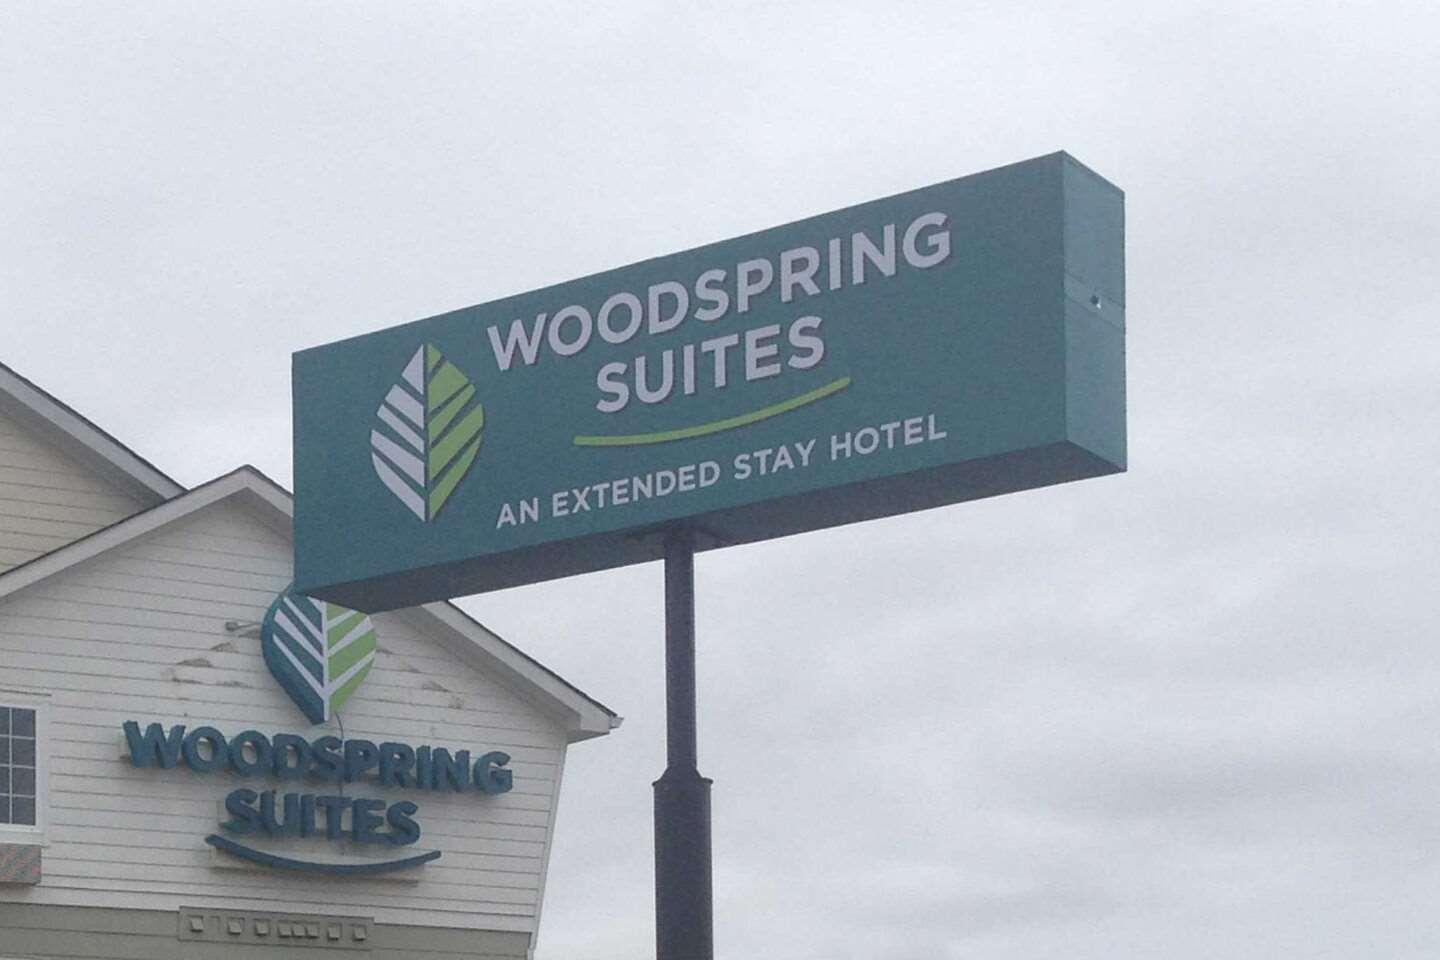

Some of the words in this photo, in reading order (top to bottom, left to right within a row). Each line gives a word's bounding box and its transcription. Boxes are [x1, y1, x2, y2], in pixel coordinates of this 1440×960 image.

[487, 212, 951, 371] WOODSPRING
[596, 315, 825, 414] SUITES
[496, 498, 540, 528] AN
[552, 462, 720, 518] EXTENDED
[734, 440, 817, 480] STAY
[830, 413, 947, 458] HOTEL
[122, 720, 513, 795] WOODSPRING
[222, 788, 421, 846] SUITES
